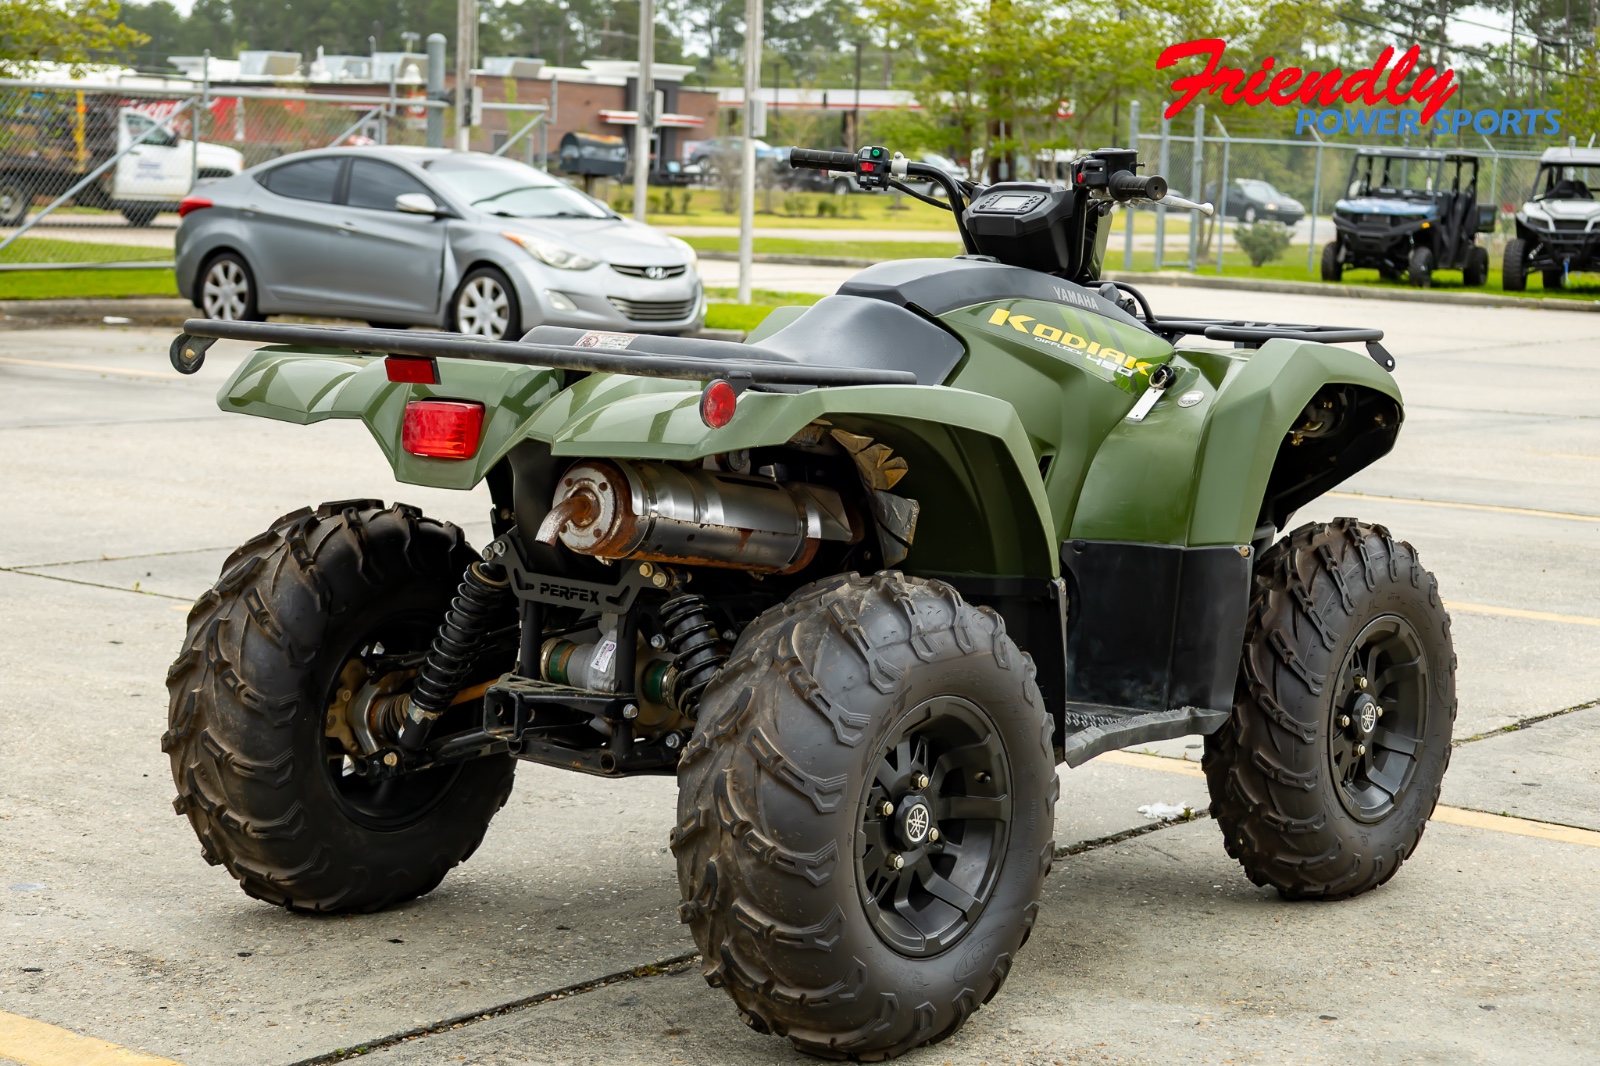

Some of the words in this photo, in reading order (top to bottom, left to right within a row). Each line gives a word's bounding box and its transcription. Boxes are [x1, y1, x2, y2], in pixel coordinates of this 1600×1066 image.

[1053, 286, 1100, 311] YAMAHA
[988, 308, 1153, 376] KODIAK
[1034, 336, 1083, 356] DIFFLOCK
[1085, 353, 1134, 377] 450
[539, 582, 600, 606] PERFEX
